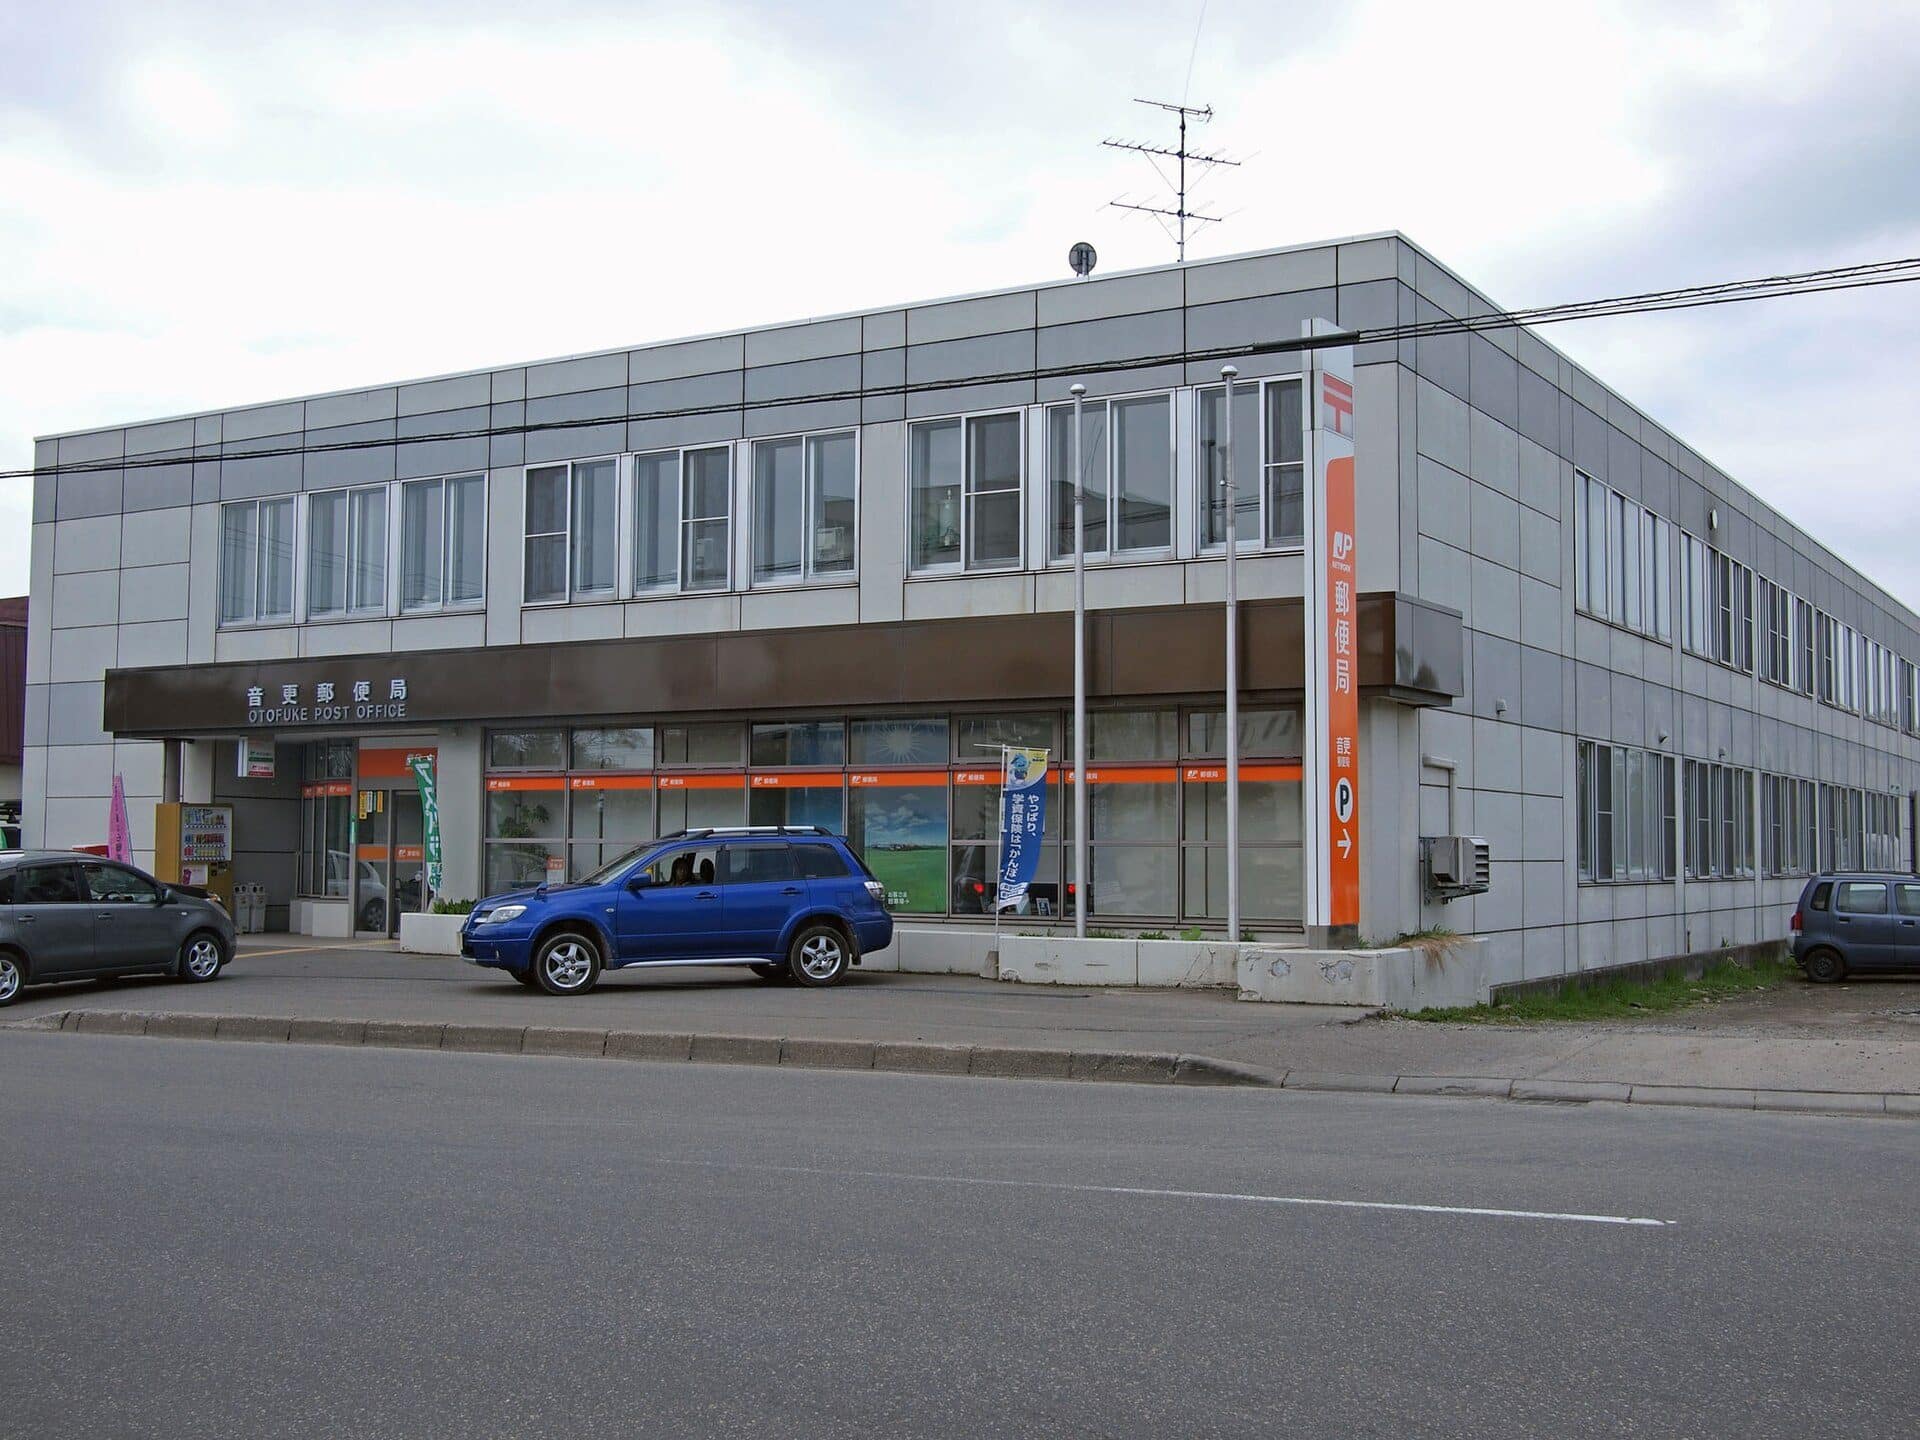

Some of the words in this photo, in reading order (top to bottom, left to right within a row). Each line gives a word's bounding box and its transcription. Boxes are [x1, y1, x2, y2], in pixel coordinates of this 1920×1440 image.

[1334, 580, 1350, 694] 郵便局
[247, 679, 408, 707] 音更郵便局
[249, 706, 308, 724] OTOFUKE
[314, 705, 350, 721] POST
[356, 703, 407, 719] OFFICE
